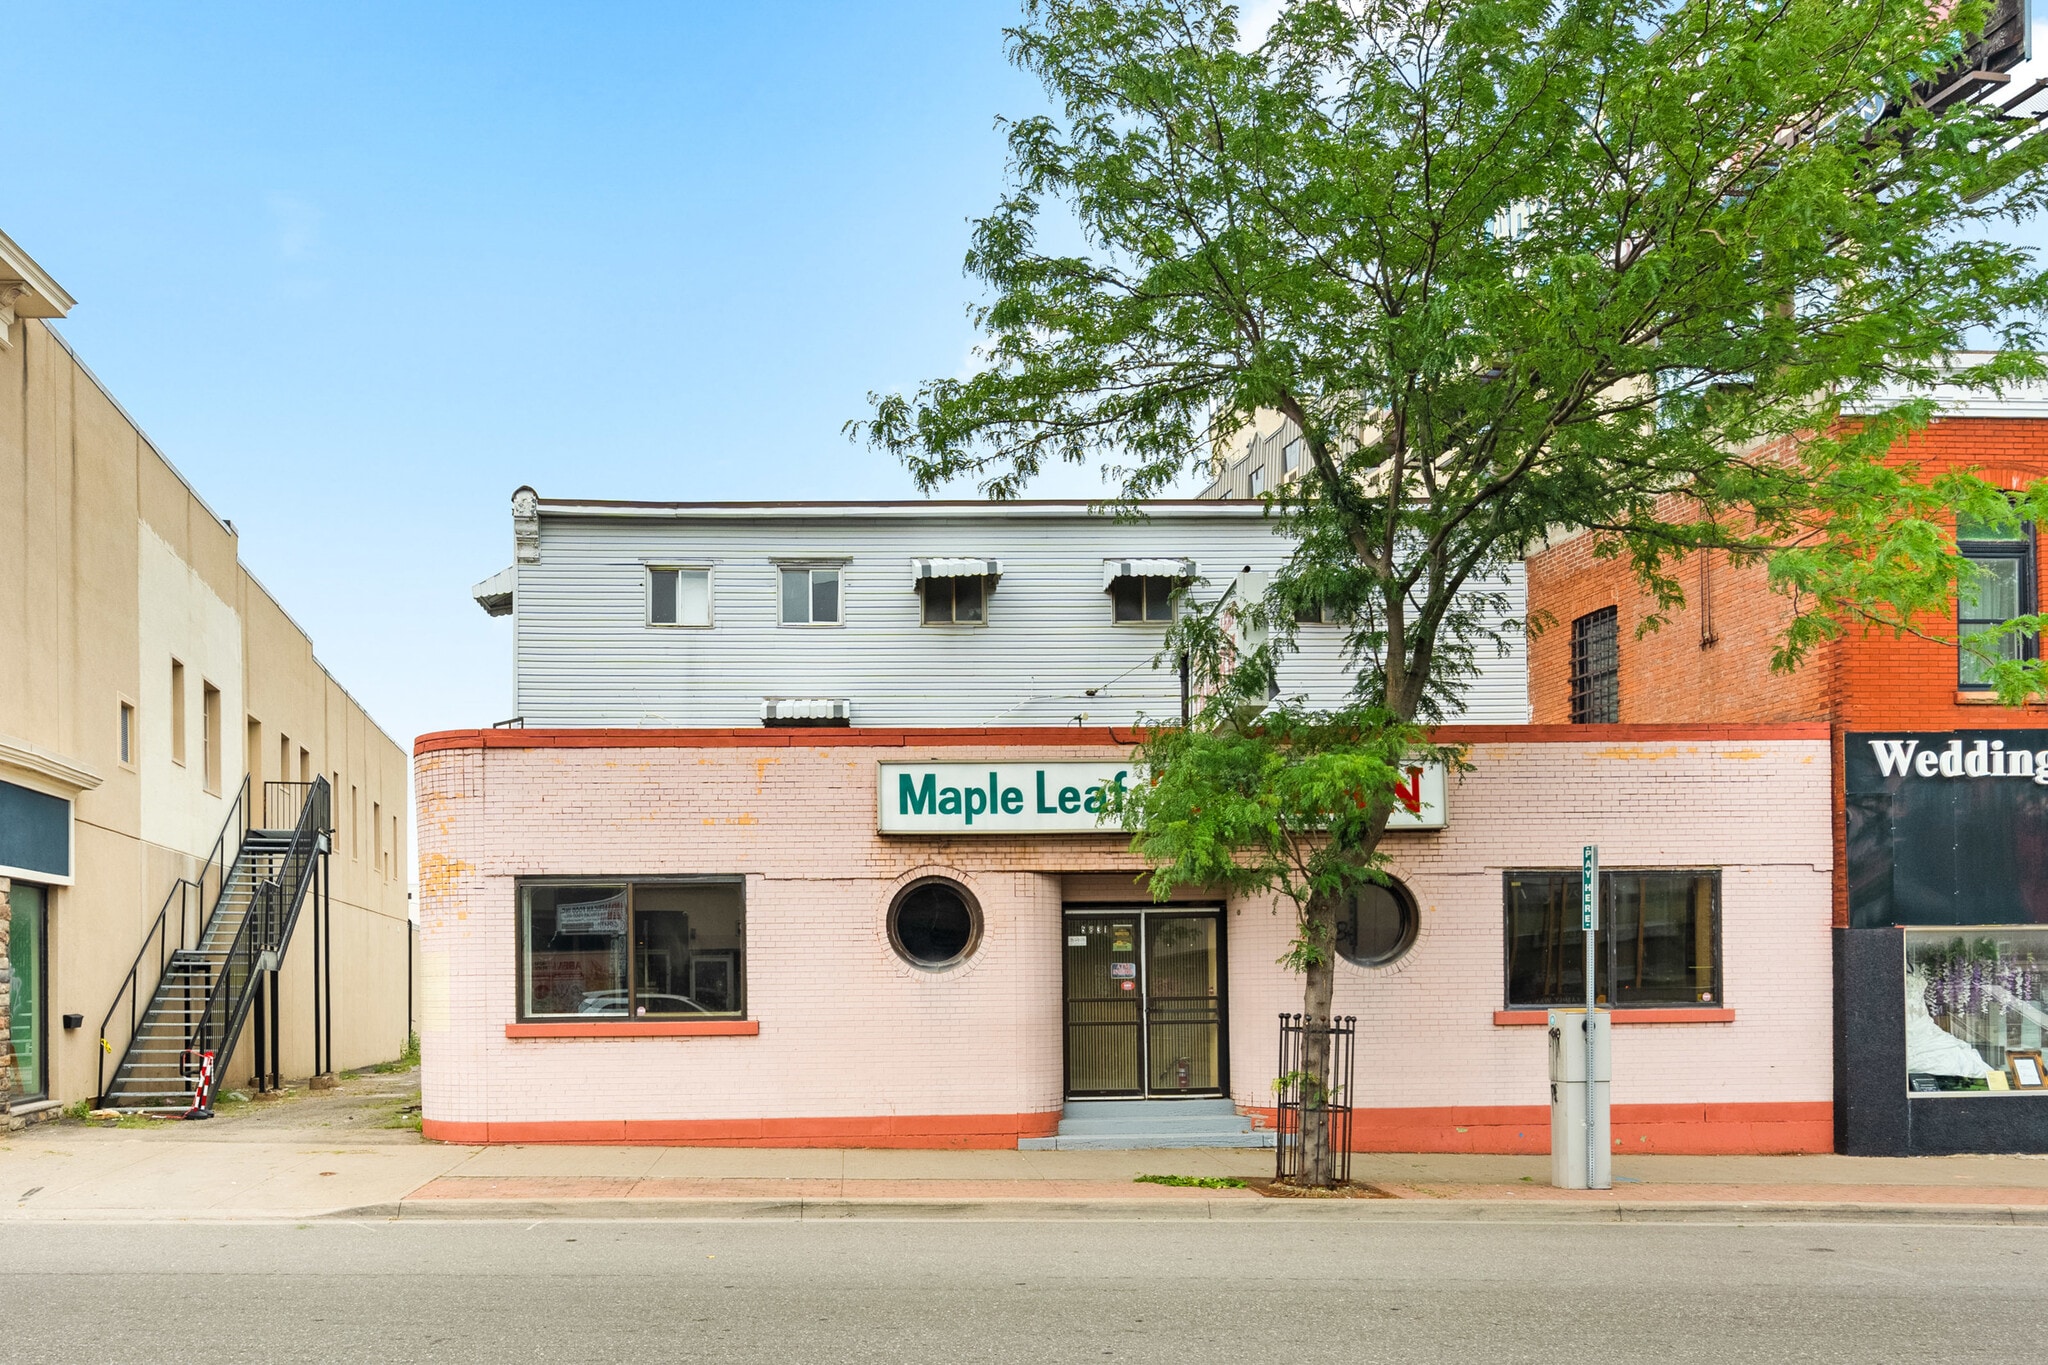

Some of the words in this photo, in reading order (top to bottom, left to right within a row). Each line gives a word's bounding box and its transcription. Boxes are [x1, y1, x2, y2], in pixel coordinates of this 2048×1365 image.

[899, 771, 1024, 825] Maple
[1036, 770, 1127, 814] Leaf
[1584, 849, 1592, 878] PAY
[1584, 883, 1592, 923] HERE
